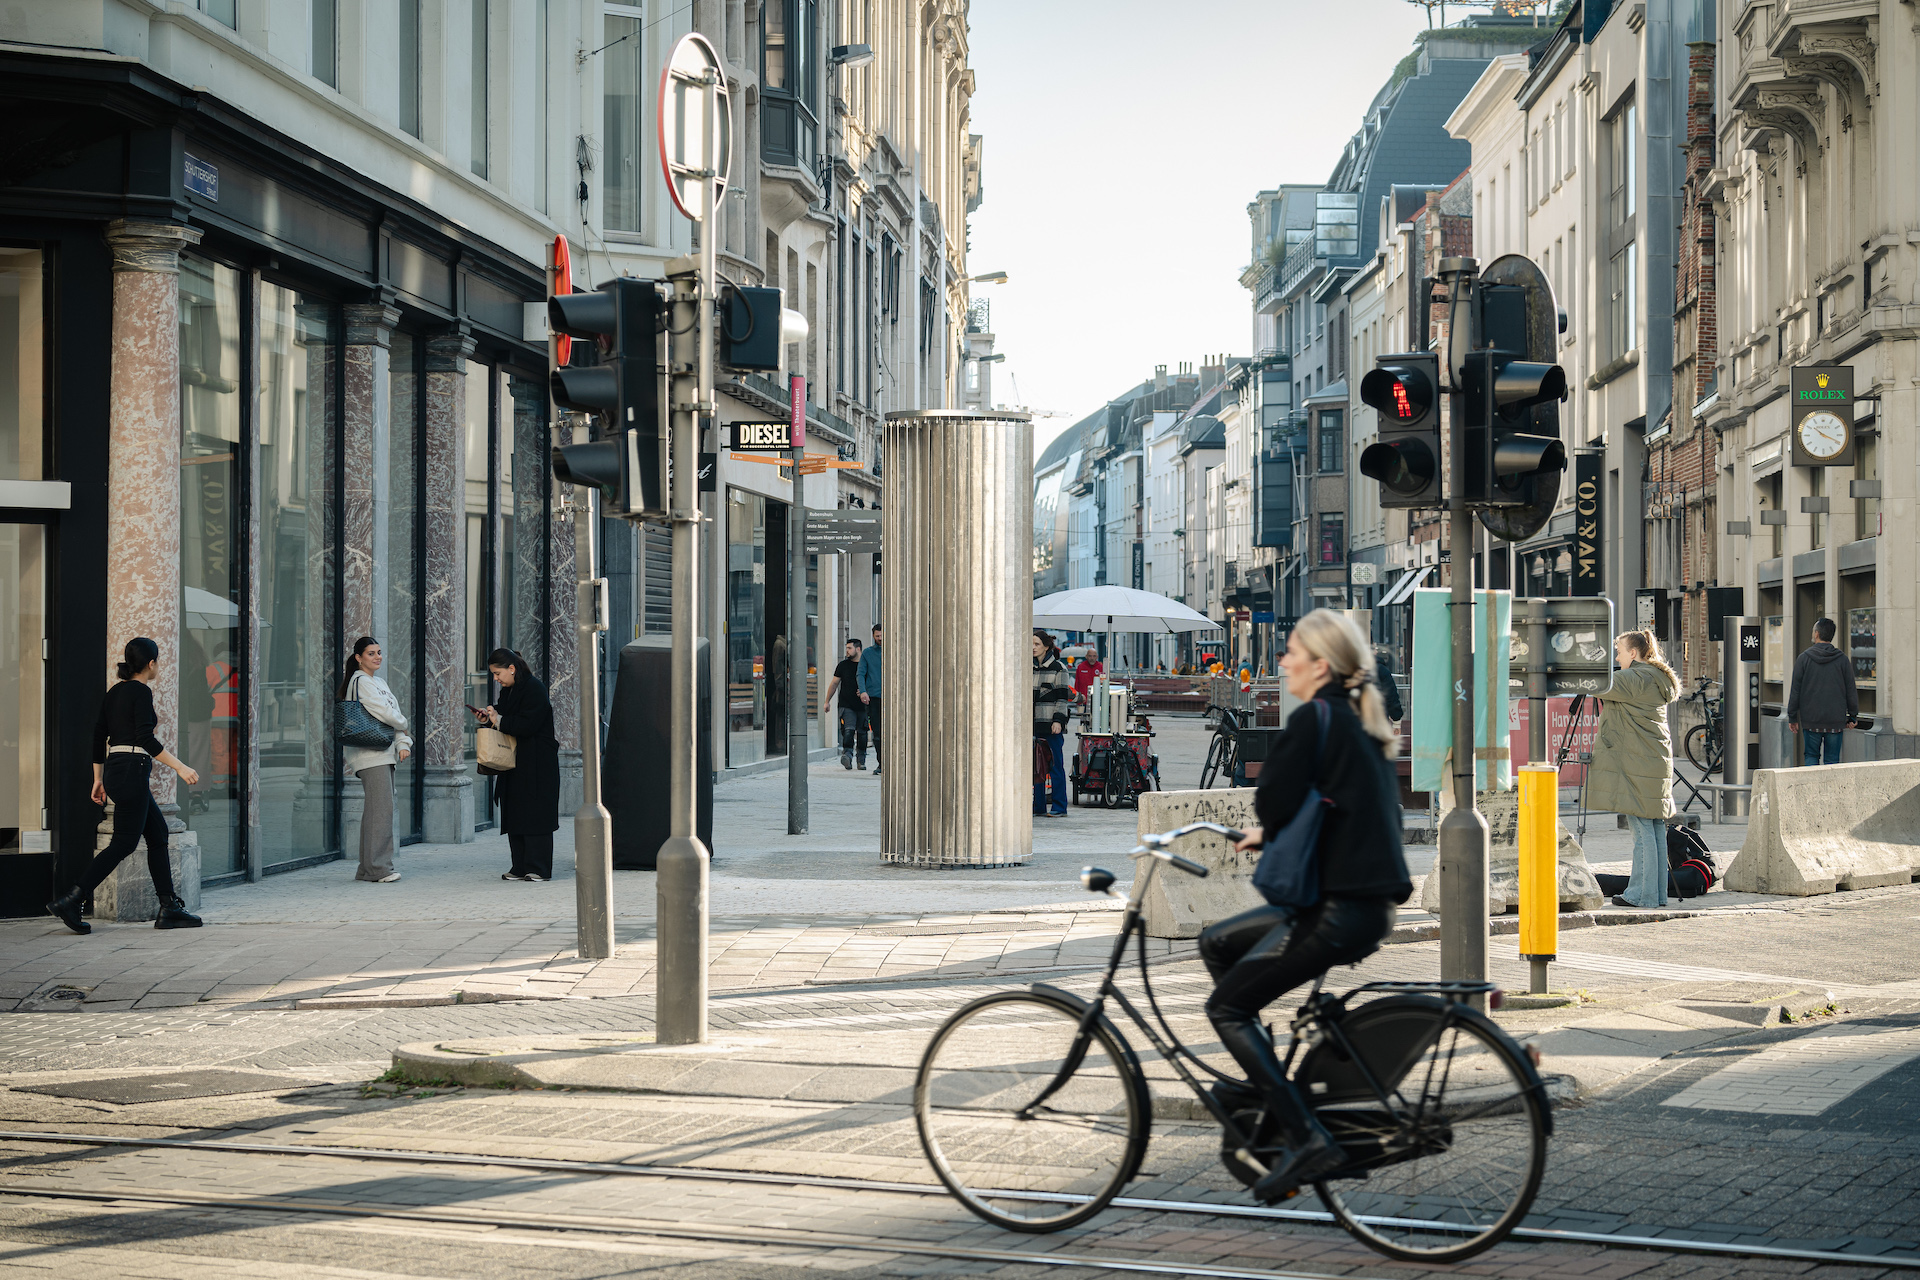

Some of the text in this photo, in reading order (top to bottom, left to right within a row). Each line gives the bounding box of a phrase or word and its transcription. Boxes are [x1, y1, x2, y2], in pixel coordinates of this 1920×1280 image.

[184, 160, 217, 186] SCHUTTERSHOF
[1799, 390, 1846, 400] ROLEX
[739, 424, 790, 445] DIESEL
[1551, 733, 1564, 747] en
